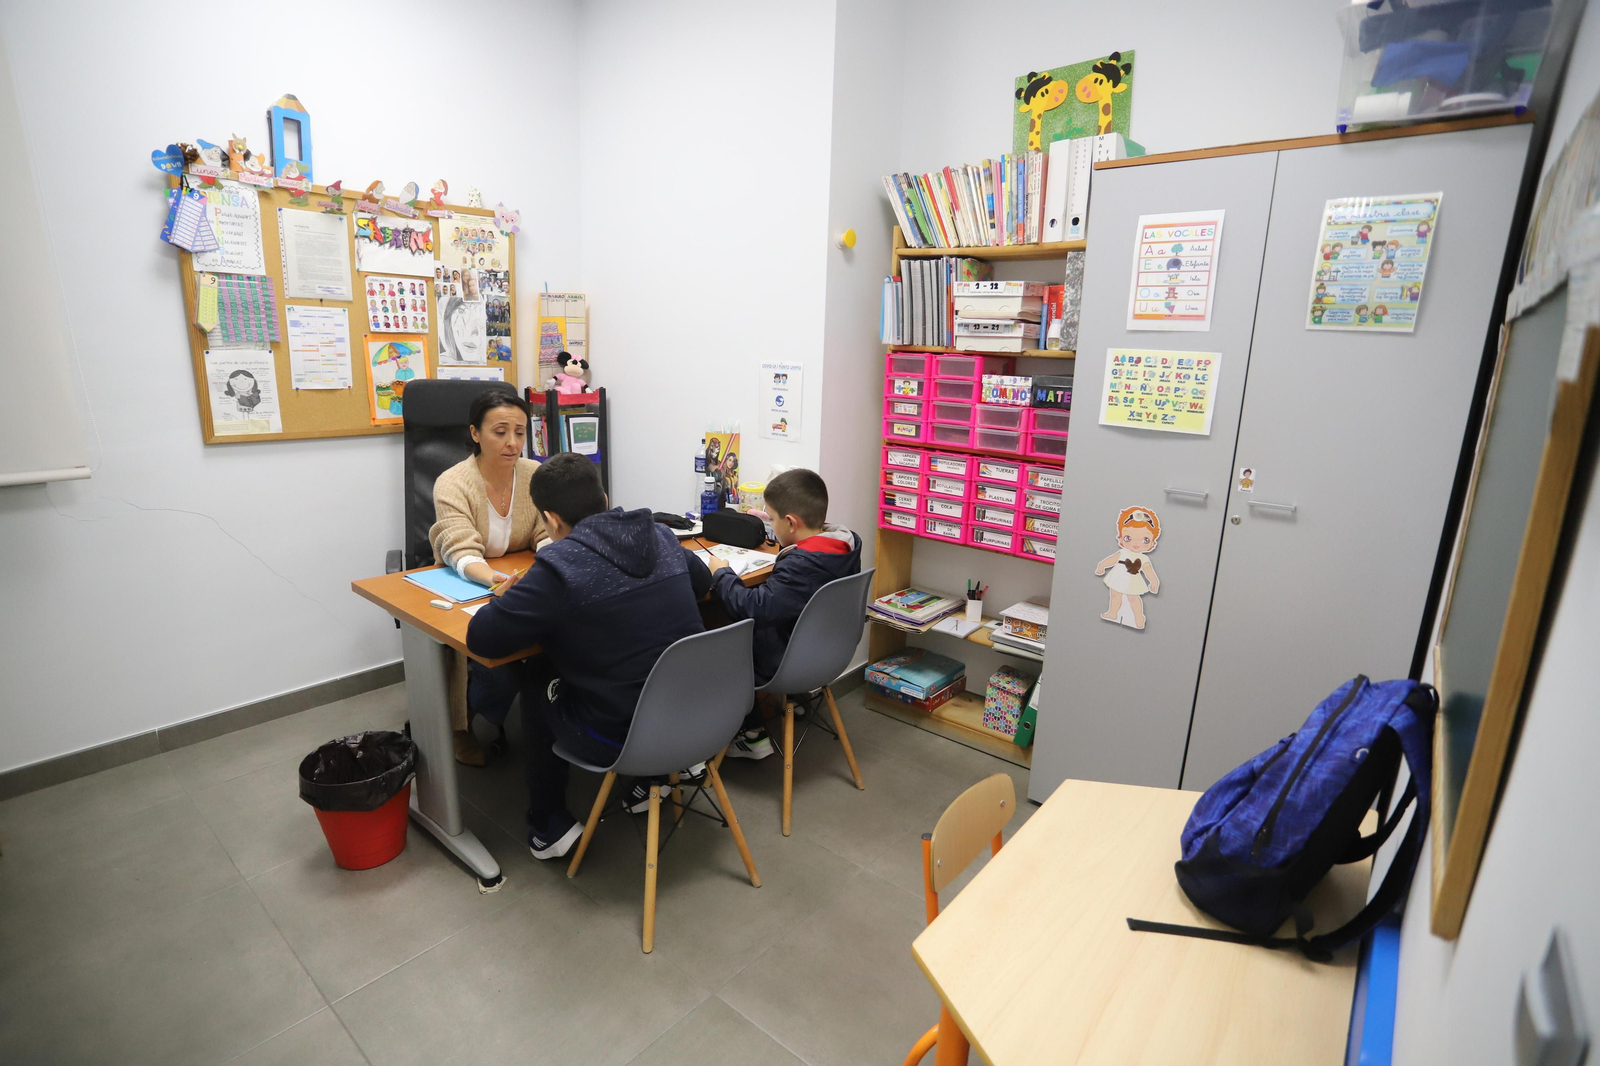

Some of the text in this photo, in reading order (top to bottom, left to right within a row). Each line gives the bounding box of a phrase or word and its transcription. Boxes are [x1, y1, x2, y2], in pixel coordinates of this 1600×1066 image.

[190, 164, 218, 176] Lunes
[1394, 207, 1420, 217] clase
[1144, 228, 1214, 240] LAS VOCALES
[1144, 245, 1154, 256] A
[1144, 259, 1152, 270] E
[210, 276, 216, 286] 9
[990, 282, 999, 290] 12
[1140, 287, 1151, 299] O
[1139, 302, 1148, 313] U
[973, 323, 981, 331] 13
[991, 323, 1000, 331] 21
[1175, 372, 1183, 380] K
[984, 386, 1028, 402] DOMINO
[1140, 383, 1147, 391] Ñ
[1157, 385, 1164, 393] O
[1191, 388, 1199, 396] Q
[1037, 389, 1071, 403] MATE
[1189, 402, 1199, 410] W
[938, 460, 966, 468] ROTULADORES
[996, 467, 1015, 475] TIJERAS
[988, 494, 1013, 503] PLASTILINA
[986, 515, 1012, 525] PURPURINAS
[983, 537, 1010, 547] PURPURINAS
